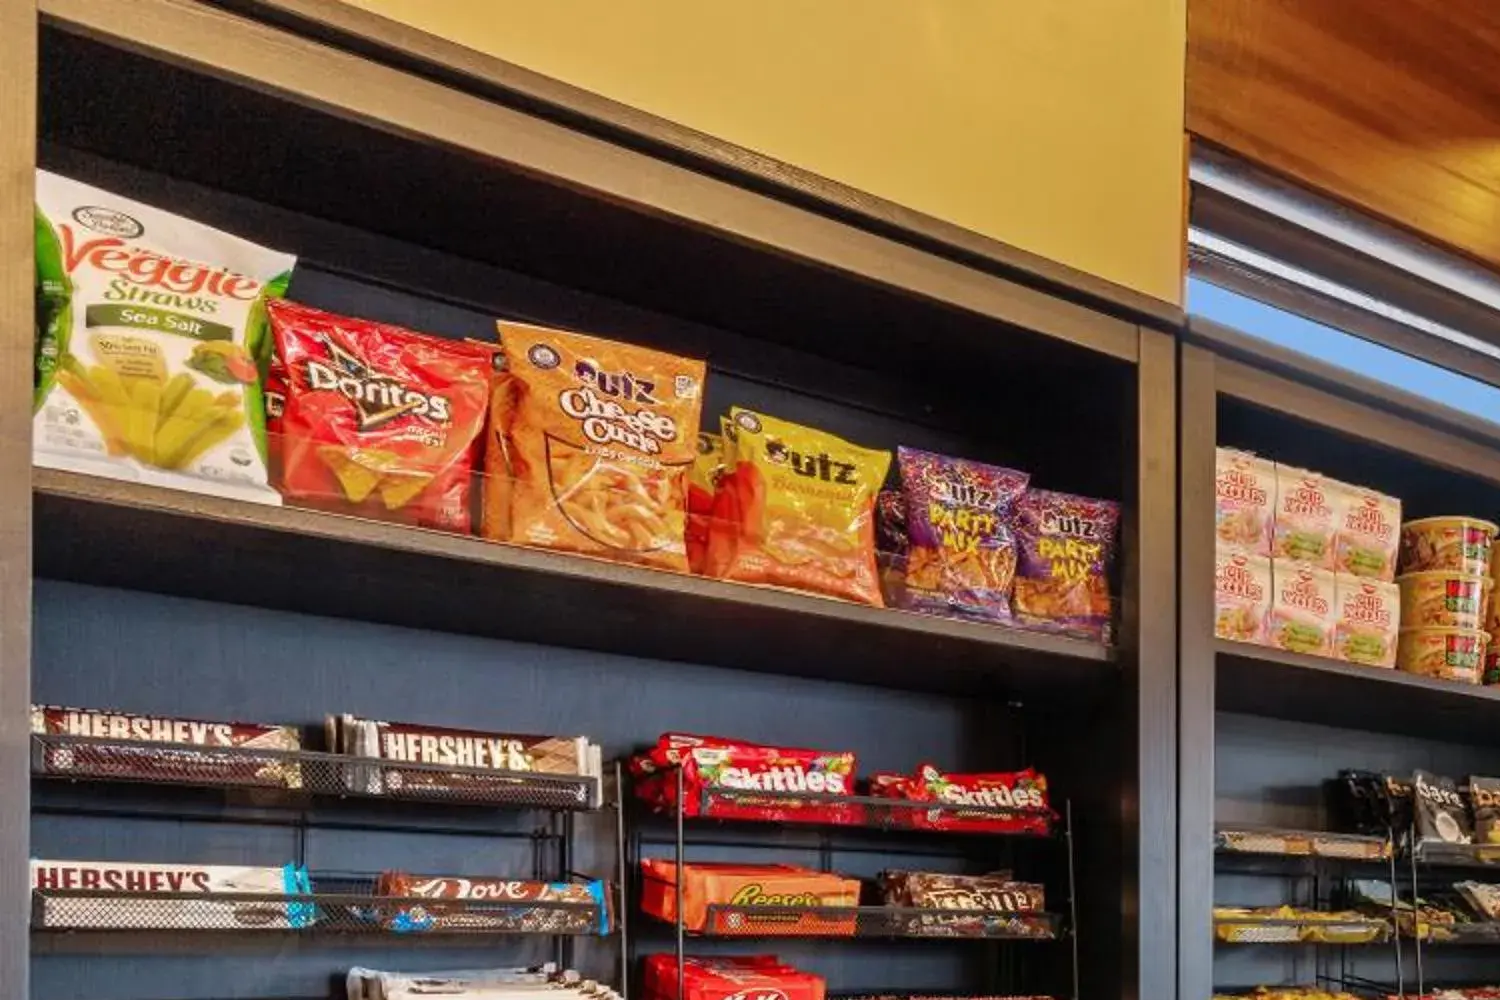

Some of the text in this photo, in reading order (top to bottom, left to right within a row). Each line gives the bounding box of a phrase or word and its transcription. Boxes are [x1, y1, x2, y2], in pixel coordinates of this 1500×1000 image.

[58, 223, 258, 300] Veggie
[104, 279, 219, 314] Straws
[119, 309, 204, 333] Sea Salt
[307, 361, 449, 420] Doritos
[560, 386, 677, 440] Cheese
[583, 416, 662, 455] Curls
[928, 501, 994, 533] PARTY
[943, 532, 981, 555] MIX
[1038, 537, 1102, 559] PARTY
[1052, 559, 1091, 580] MIX
[67, 712, 233, 747] HERSHEY'S
[387, 732, 525, 771] HERSHEY'S
[720, 764, 843, 793] Skittles
[944, 783, 1043, 808] Skittles
[1415, 774, 1463, 809] bare
